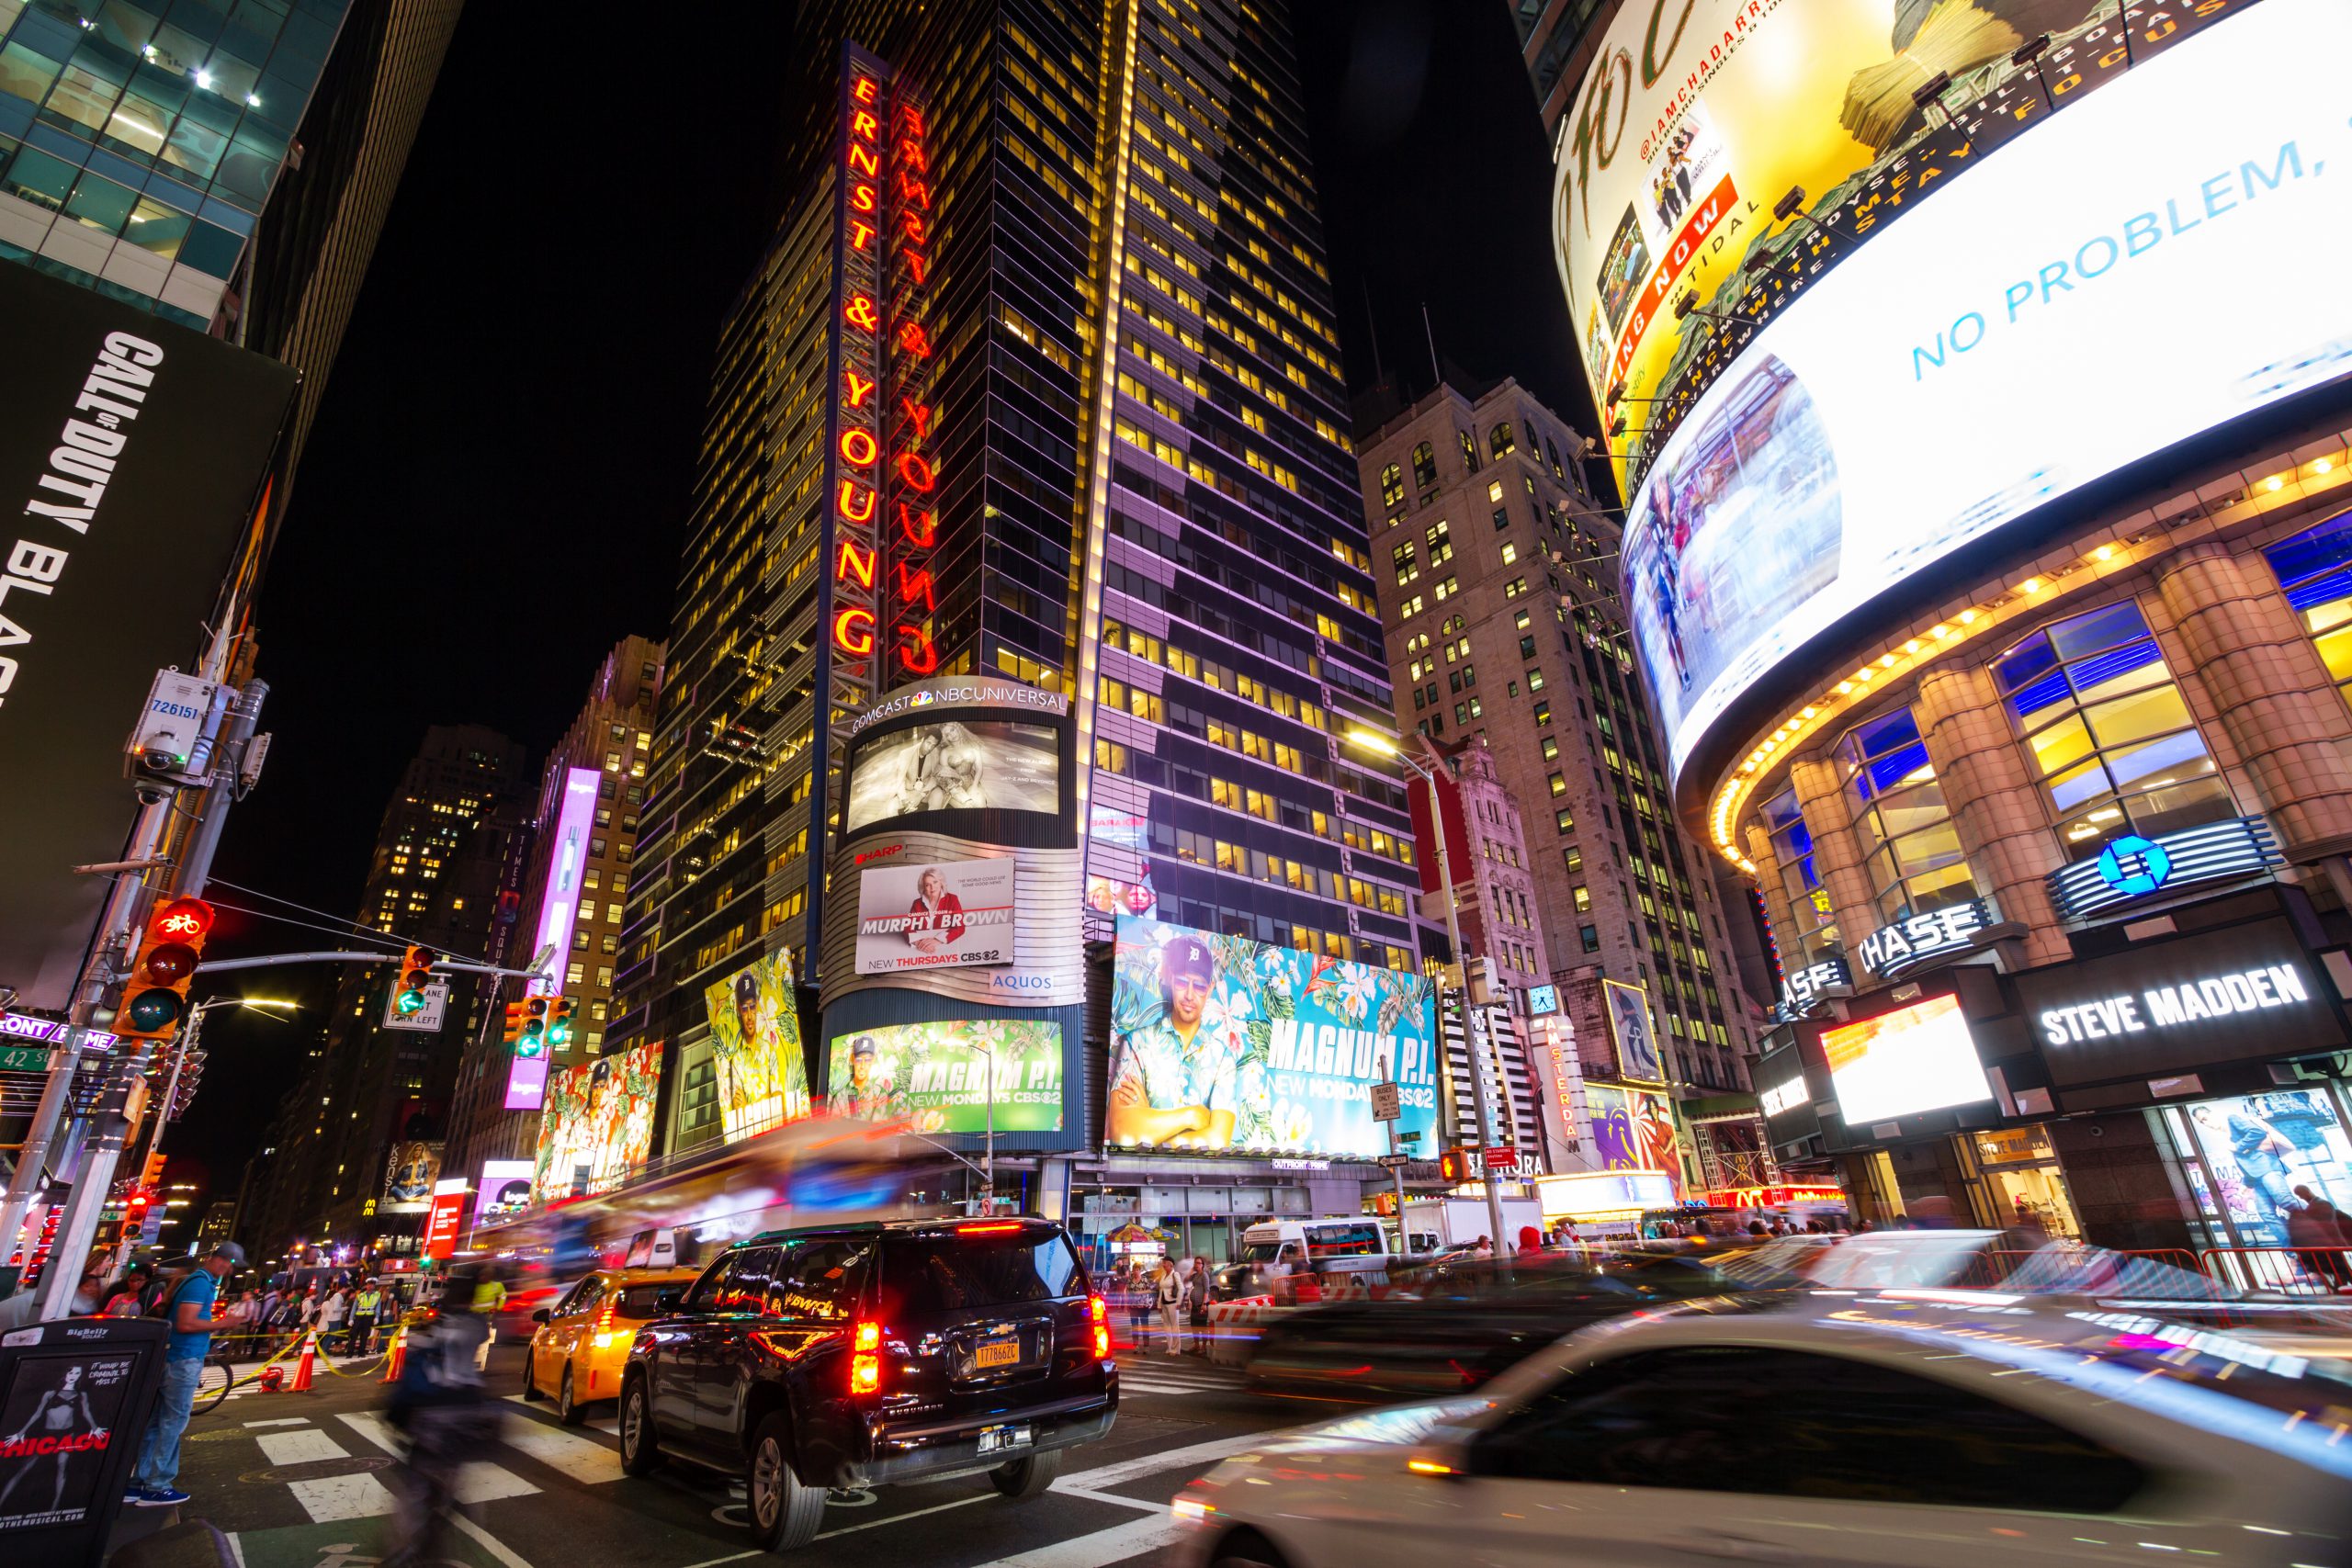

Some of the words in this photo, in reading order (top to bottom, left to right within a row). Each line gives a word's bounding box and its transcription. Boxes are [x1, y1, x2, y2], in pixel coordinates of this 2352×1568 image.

[1640, 0, 1770, 161] @IAMCHADARR
[1646, 94, 1696, 165] BILLBOARD
[1697, 36, 1745, 93] SINGLES
[1855, 138, 1974, 234] STAY
[2014, 0, 2226, 121] FOCUS
[849, 76, 879, 251] ERNST
[1654, 197, 1719, 297] NOW
[1687, 200, 1760, 284] TIDAL
[1747, 235, 1831, 316] WITH
[1913, 310, 1986, 382] NO
[2005, 140, 2326, 324] PROBLEM,
[845, 297, 878, 332] &
[74, 331, 164, 421] CALL
[97, 412, 120, 430] OF
[26, 418, 128, 535] DUTY
[834, 370, 878, 655] YOUNG
[153, 699, 198, 720] 726151
[853, 695, 910, 733] COMCAST
[935, 687, 1066, 710] NBCUNIVERSAL
[511, 834, 526, 887] TIMES
[855, 844, 902, 865] SHARP
[861, 915, 935, 934] MURPHY
[940, 909, 1009, 929] BROWN
[1859, 903, 1980, 974] CHASE
[868, 959, 894, 970] NEW
[896, 953, 958, 967] THURSDAYS
[424, 989, 443, 998] ANE
[993, 976, 1052, 990] AQUOS
[417, 1016, 437, 1024] LEFT
[2040, 995, 2145, 1045] STEVE
[2143, 964, 2309, 1028] MADDEN
[0, 1016, 51, 1038] ONT
[59, 1025, 112, 1050] PME
[4, 1051, 25, 1067] 42
[1266, 1018, 1397, 1081] MAGNUM
[1399, 1036, 1435, 1086] P.I.
[909, 1059, 1023, 1094] MAGNUM
[1026, 1060, 1062, 1090] P.I.
[1267, 1073, 1308, 1096] NEW
[1308, 1077, 1374, 1103] MONDAY
[1376, 1087, 1392, 1095] BUSES
[1545, 1015, 1581, 1154] AMSTERDAM
[908, 1095, 940, 1108] NEW
[1978, 1139, 2008, 1156] STEVE
[2008, 1134, 2051, 1152] MADDEN
[1274, 1159, 1306, 1169] OUTFRONT
[66, 1327, 109, 1336] BigBelly
[979, 1343, 1015, 1363] T778662C
[89, 1370, 119, 1379] CRIMINAL
[96, 1378, 110, 1386] MISS
